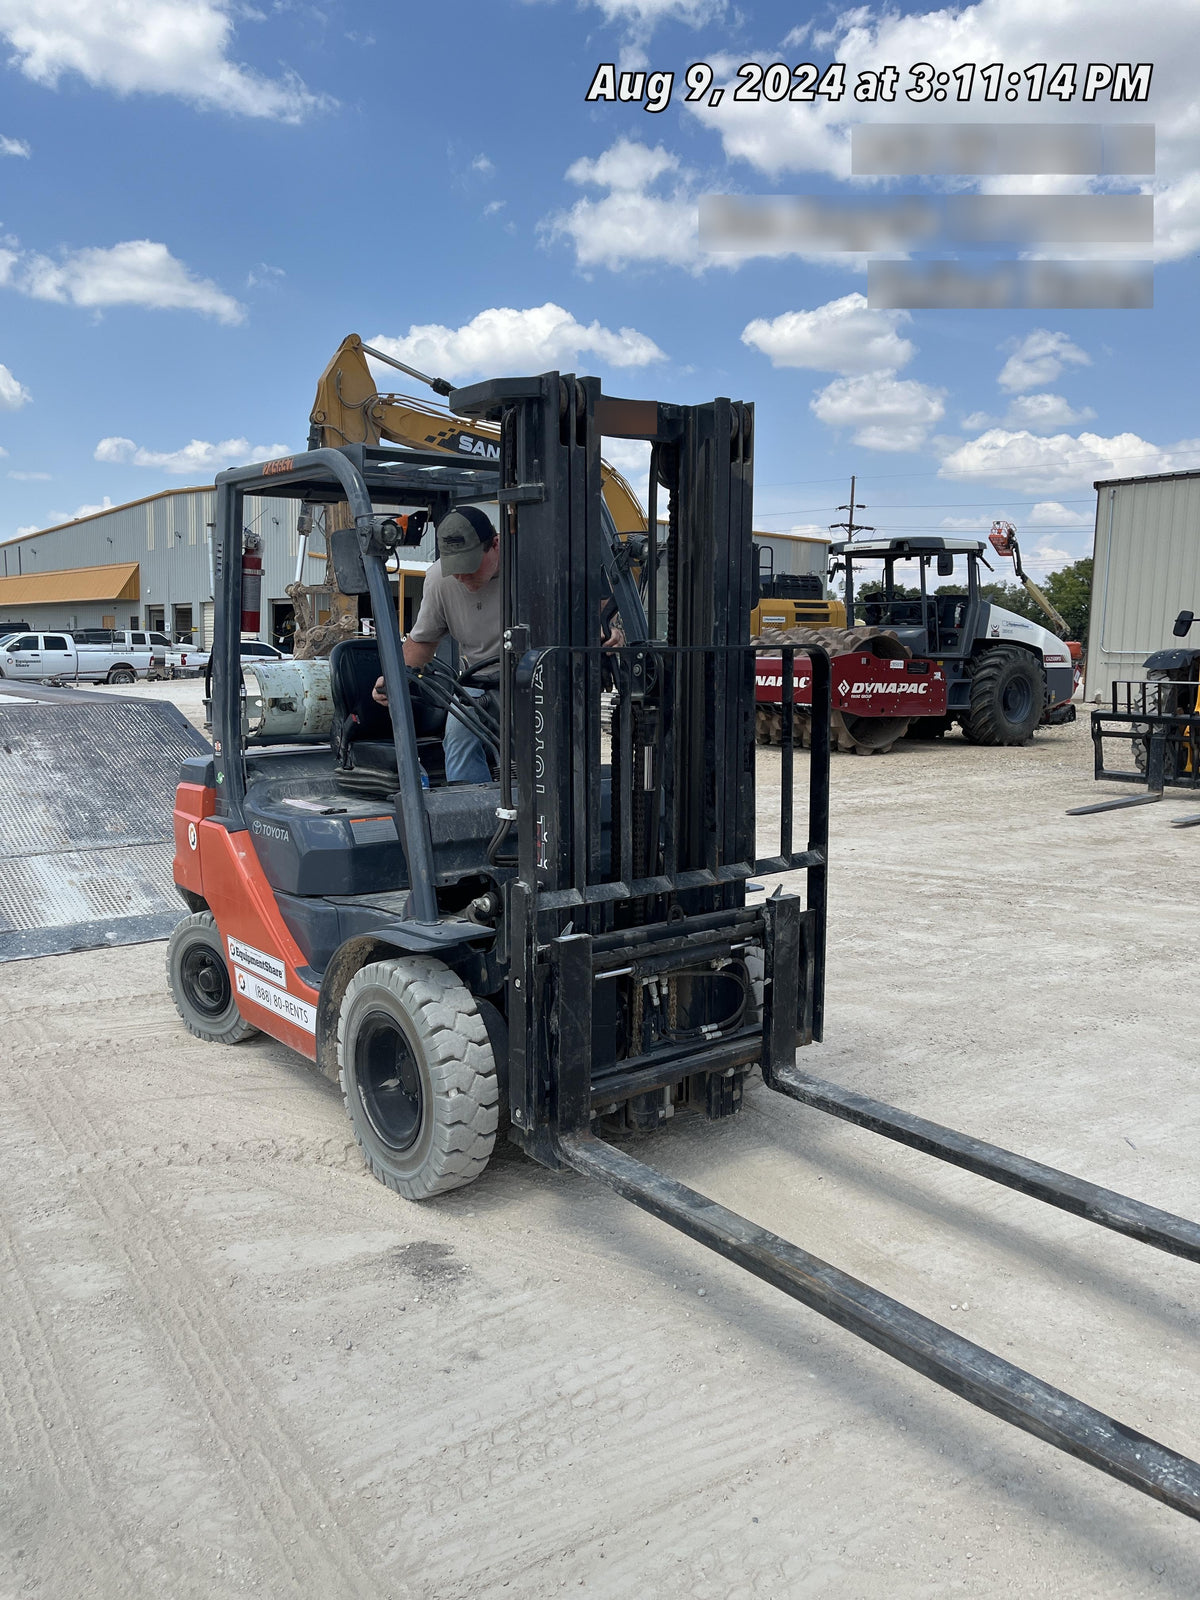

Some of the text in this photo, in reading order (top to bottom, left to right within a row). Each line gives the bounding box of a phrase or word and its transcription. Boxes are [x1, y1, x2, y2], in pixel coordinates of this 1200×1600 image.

[851, 683, 928, 694] DYNAPAC
[262, 824, 289, 842] TOYOTA
[235, 946, 283, 979] EquipmentShare
[255, 984, 309, 1024] (888) 80-RENTS
